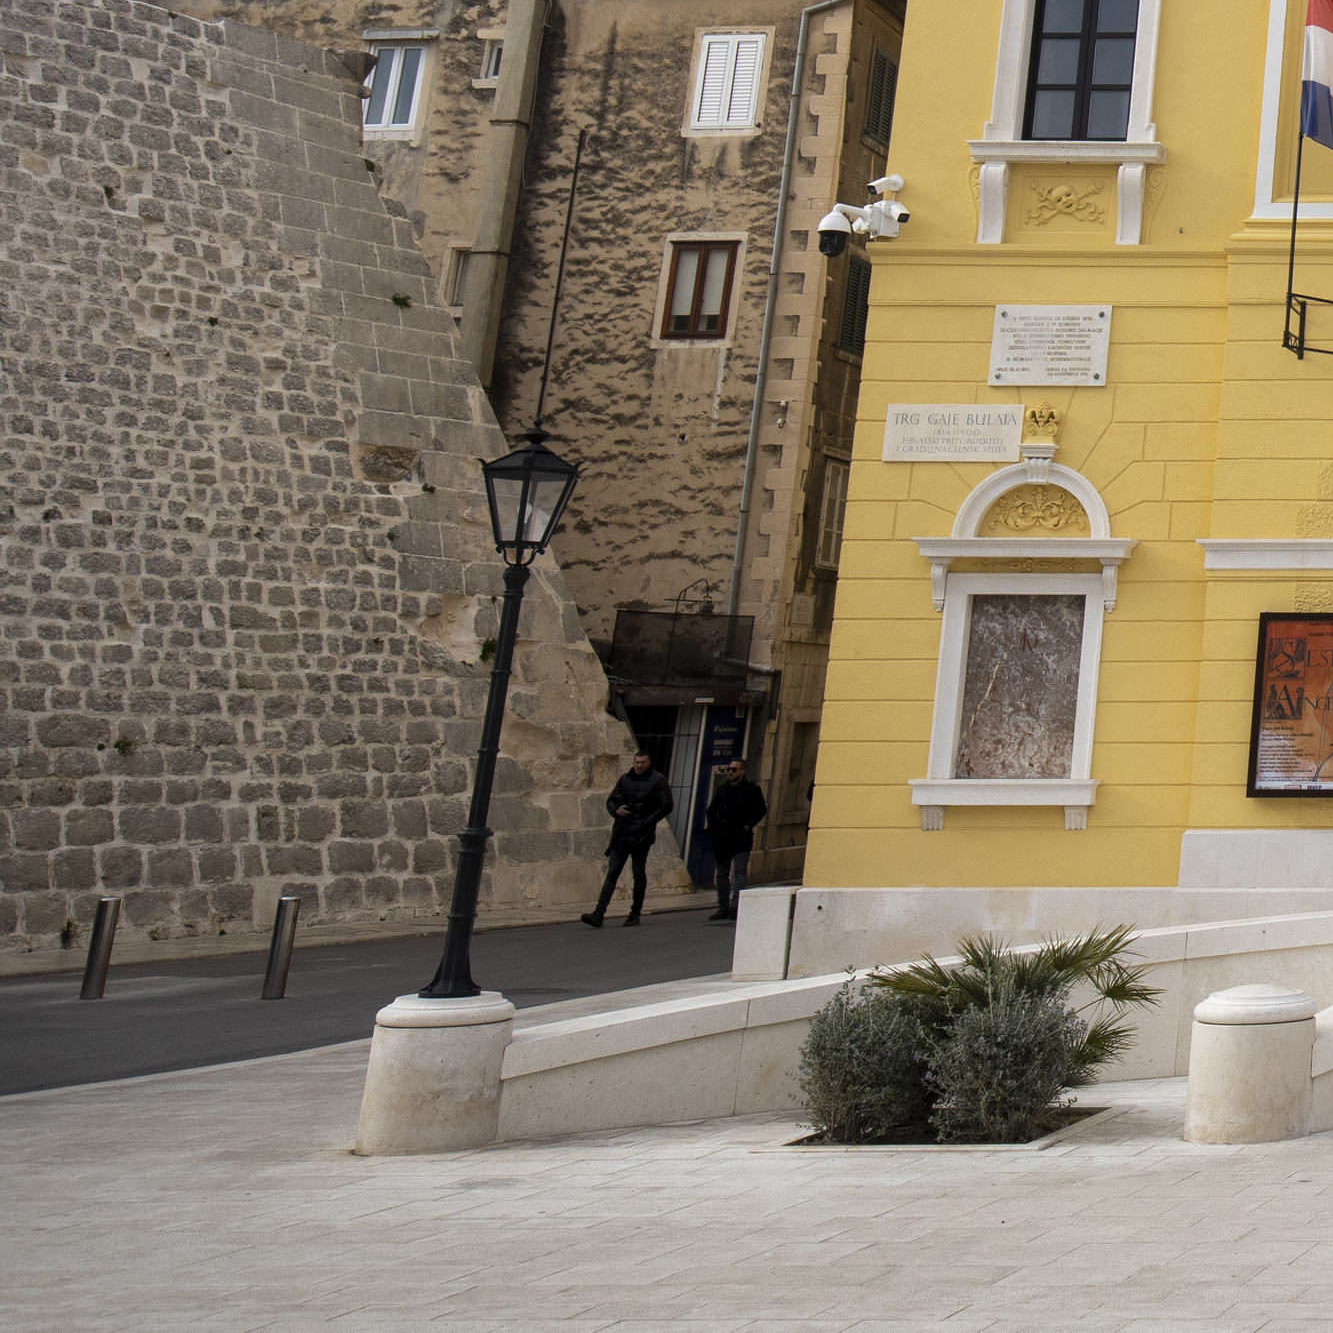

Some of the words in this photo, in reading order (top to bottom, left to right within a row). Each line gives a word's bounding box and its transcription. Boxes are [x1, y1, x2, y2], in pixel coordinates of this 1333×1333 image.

[893, 412, 921, 426] TRG
[927, 413, 961, 428] GAJE
[966, 413, 1017, 427] BULATA
[902, 436, 940, 445] HRVATSKI
